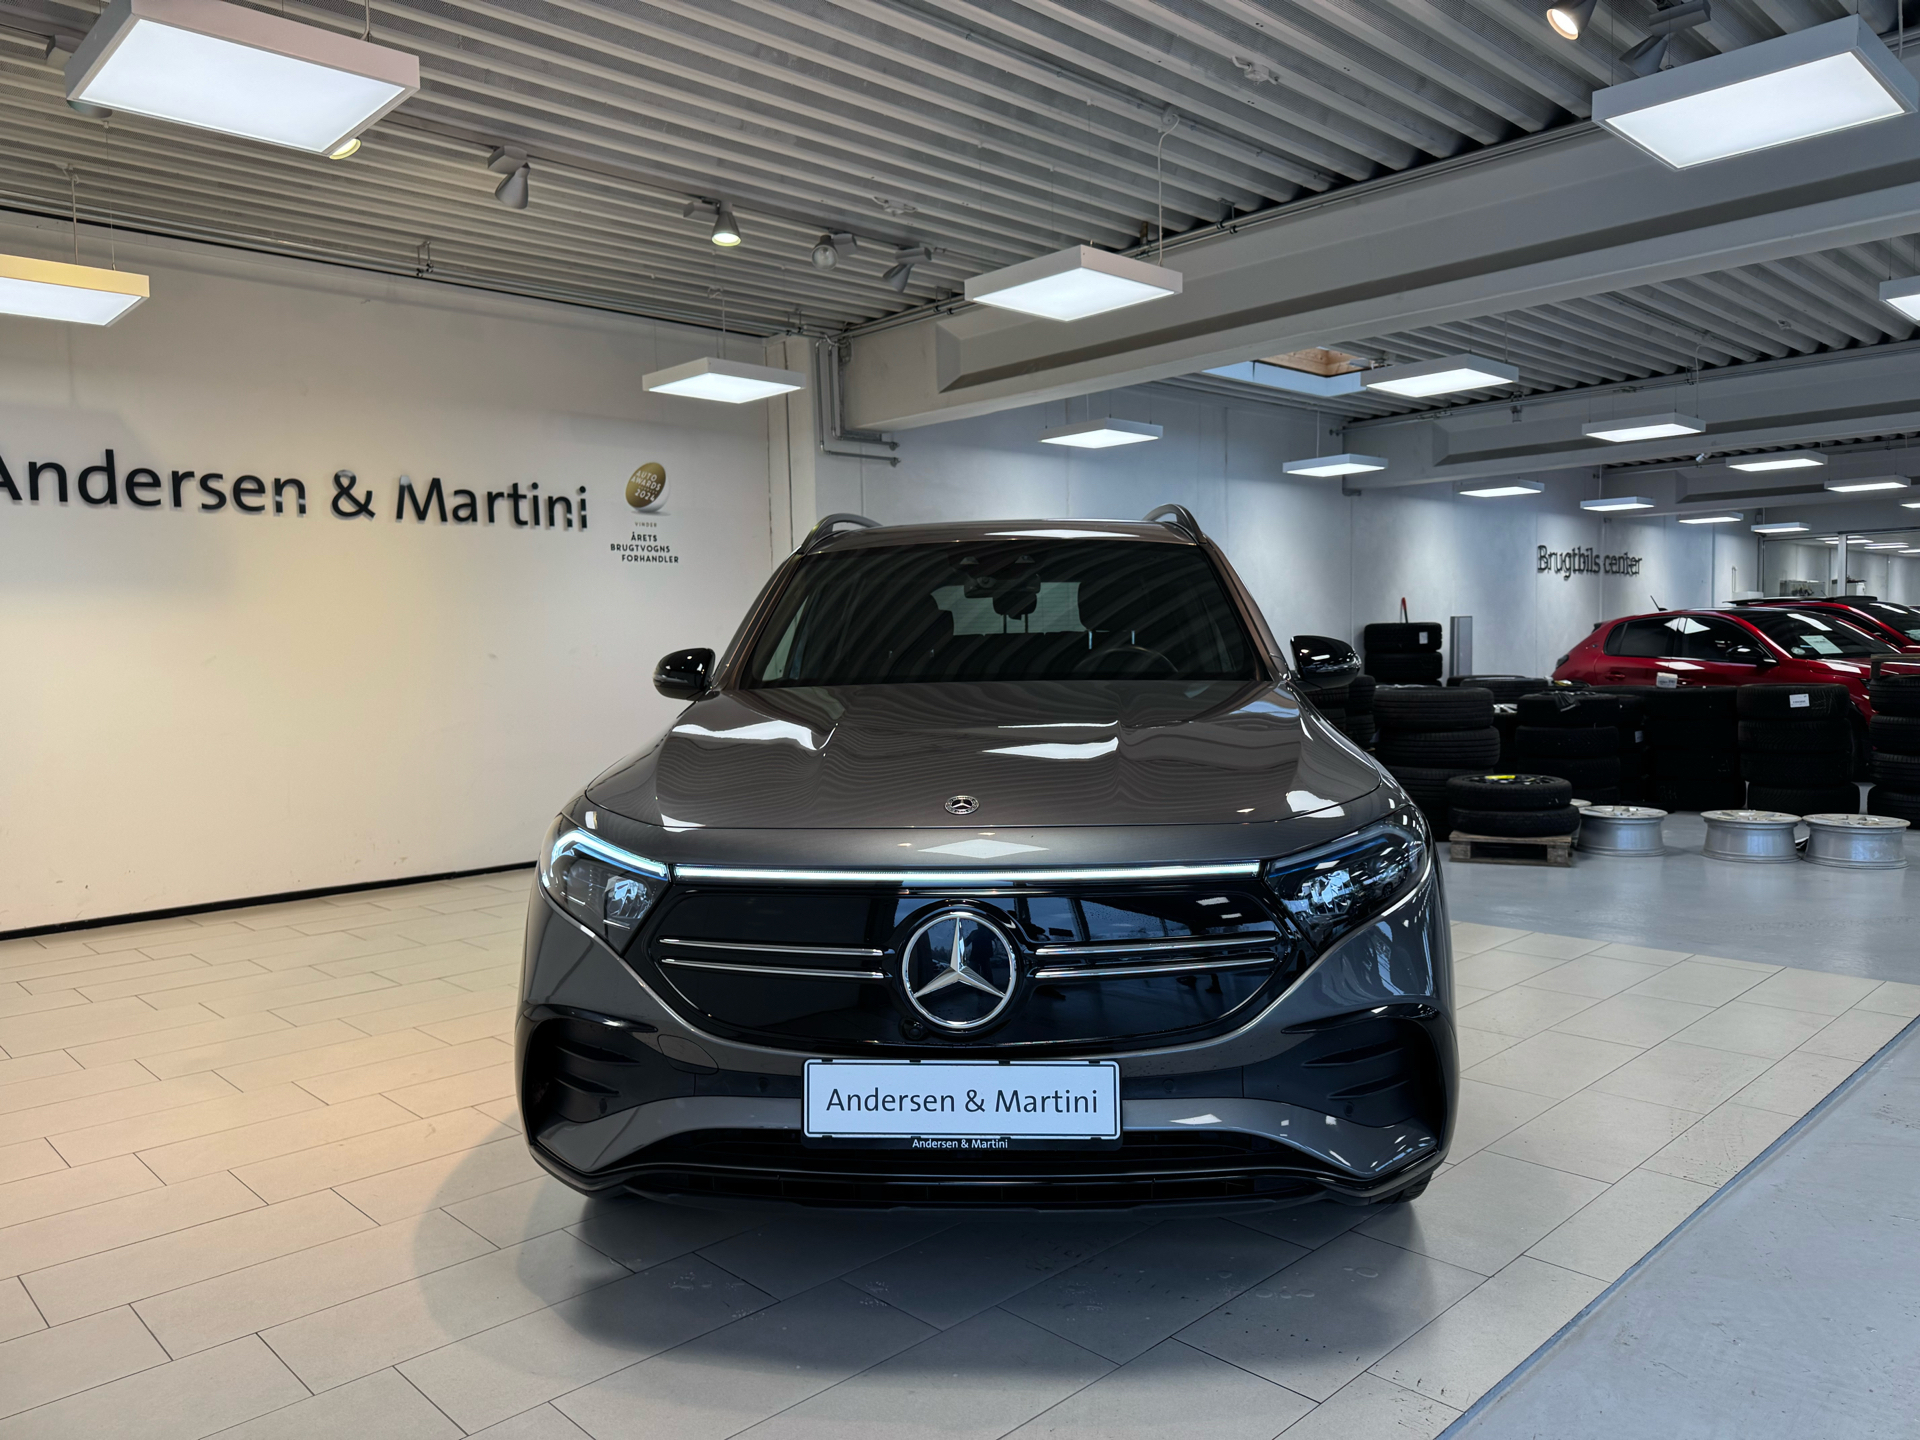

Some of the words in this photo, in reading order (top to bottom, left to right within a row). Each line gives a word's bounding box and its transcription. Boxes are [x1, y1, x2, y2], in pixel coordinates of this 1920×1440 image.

[636, 470, 658, 482] AUTO
[630, 476, 662, 492] AWARDS
[331, 469, 377, 521] &
[396, 475, 588, 530] Martini
[634, 488, 656, 502] 2024
[630, 531, 658, 542] ÅRETS
[610, 543, 671, 554] BRUGTVOGNS
[621, 553, 679, 564] FORHANDLER
[1537, 545, 1601, 580] Brugtbils
[1603, 551, 1643, 577] center
[826, 1087, 955, 1113] Andersen
[964, 1089, 986, 1113] &
[995, 1089, 1098, 1114] Martini
[912, 1138, 958, 1149] Andersen
[960, 1138, 969, 1149] &
[971, 1138, 1008, 1149] Martini
